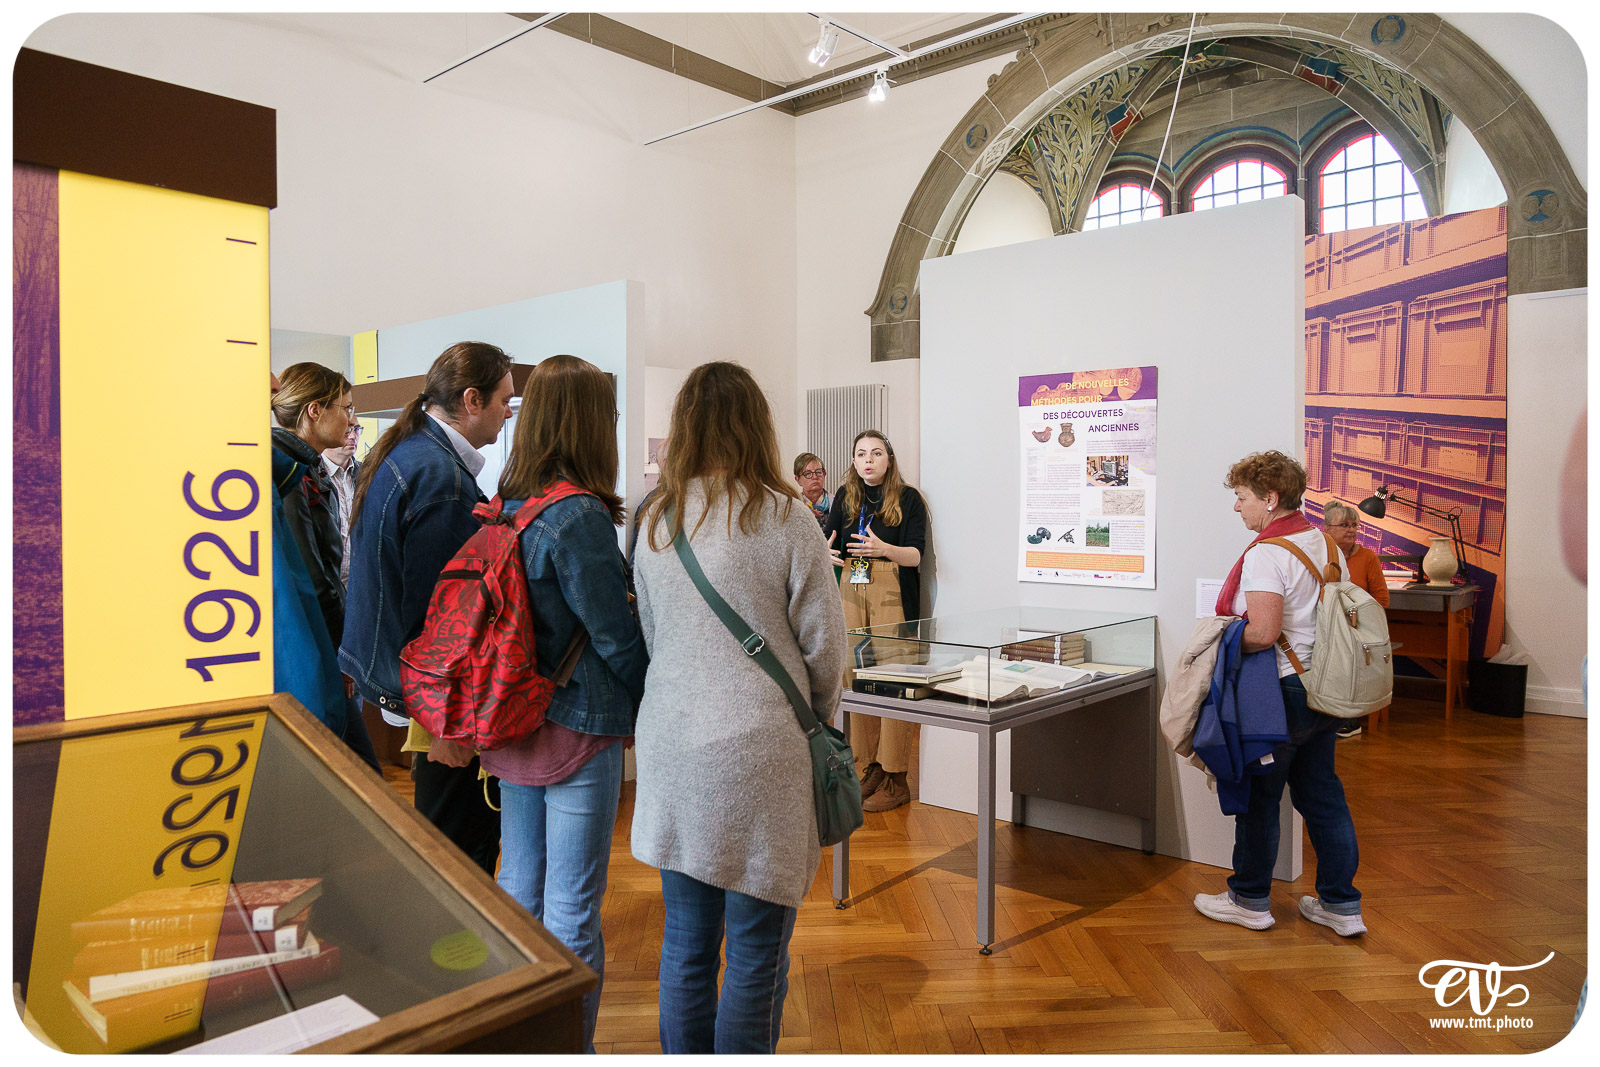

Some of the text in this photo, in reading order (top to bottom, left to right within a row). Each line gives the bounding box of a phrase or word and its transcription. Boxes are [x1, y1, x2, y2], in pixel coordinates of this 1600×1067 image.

[1065, 378, 1129, 390] DE NOUVELLES
[1031, 394, 1103, 406] MÉTHODES POUR
[1043, 408, 1124, 420] DES DÉCOUVERTES
[1088, 423, 1140, 433] ANCIENNES
[182, 468, 261, 682] 1926
